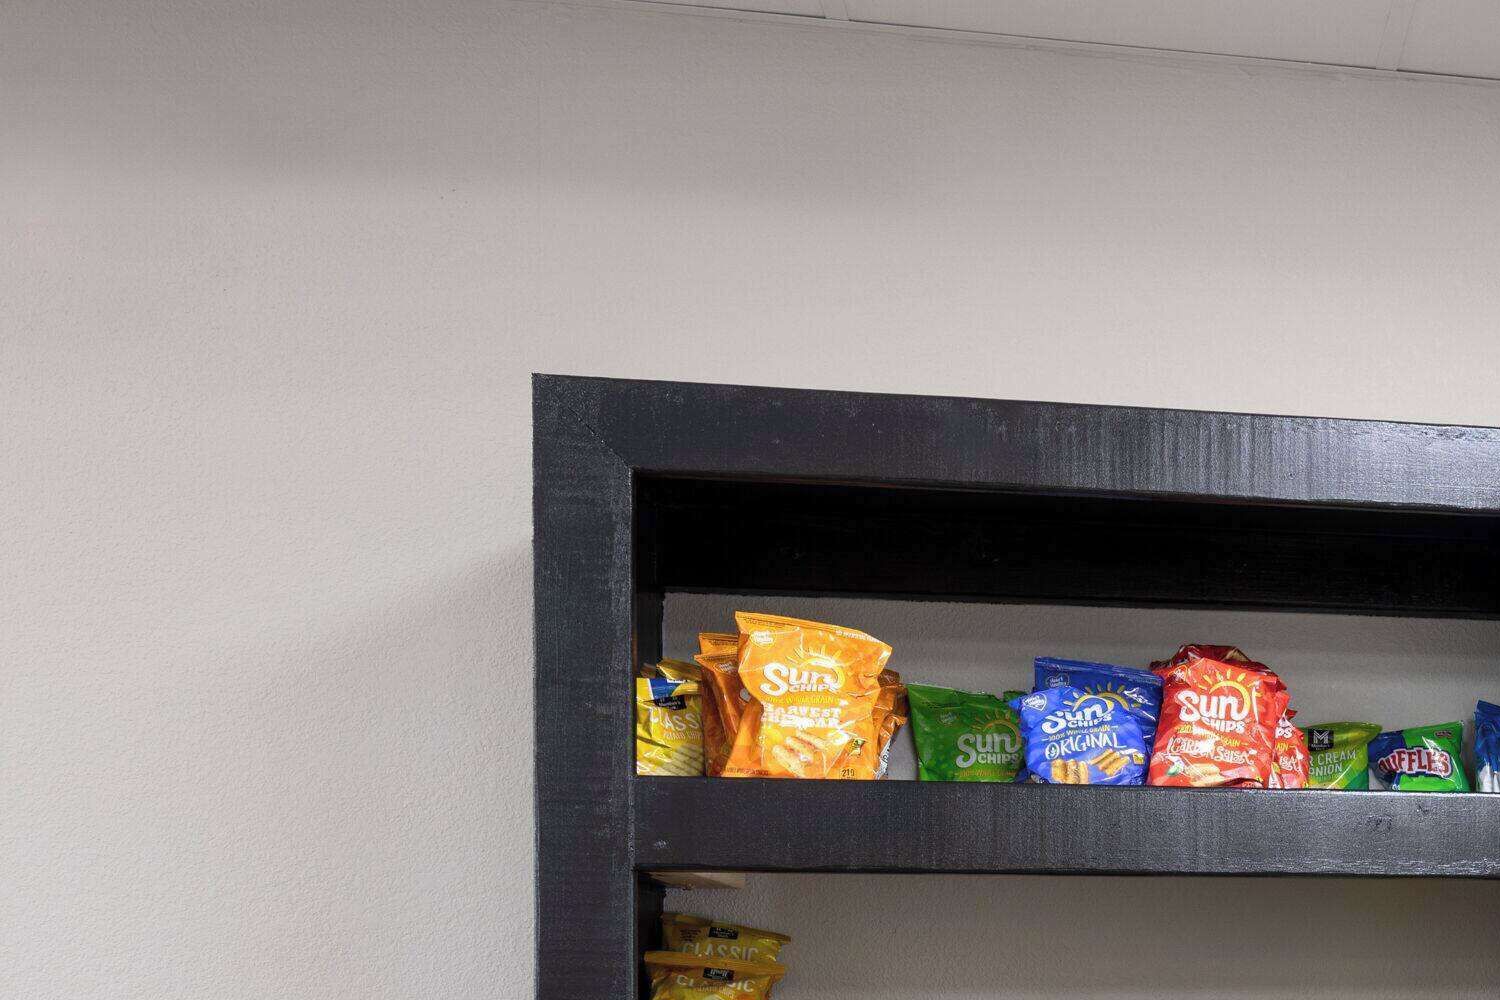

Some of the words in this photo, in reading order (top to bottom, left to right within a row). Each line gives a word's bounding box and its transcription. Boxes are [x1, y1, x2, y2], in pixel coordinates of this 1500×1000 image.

[760, 662, 834, 696] Sun
[1041, 704, 1113, 734] Sun
[1177, 690, 1250, 722] Sun
[955, 733, 1019, 768] Sun
[1045, 732, 1127, 760] ORIGINAL
[1317, 750, 1356, 766] CREAM
